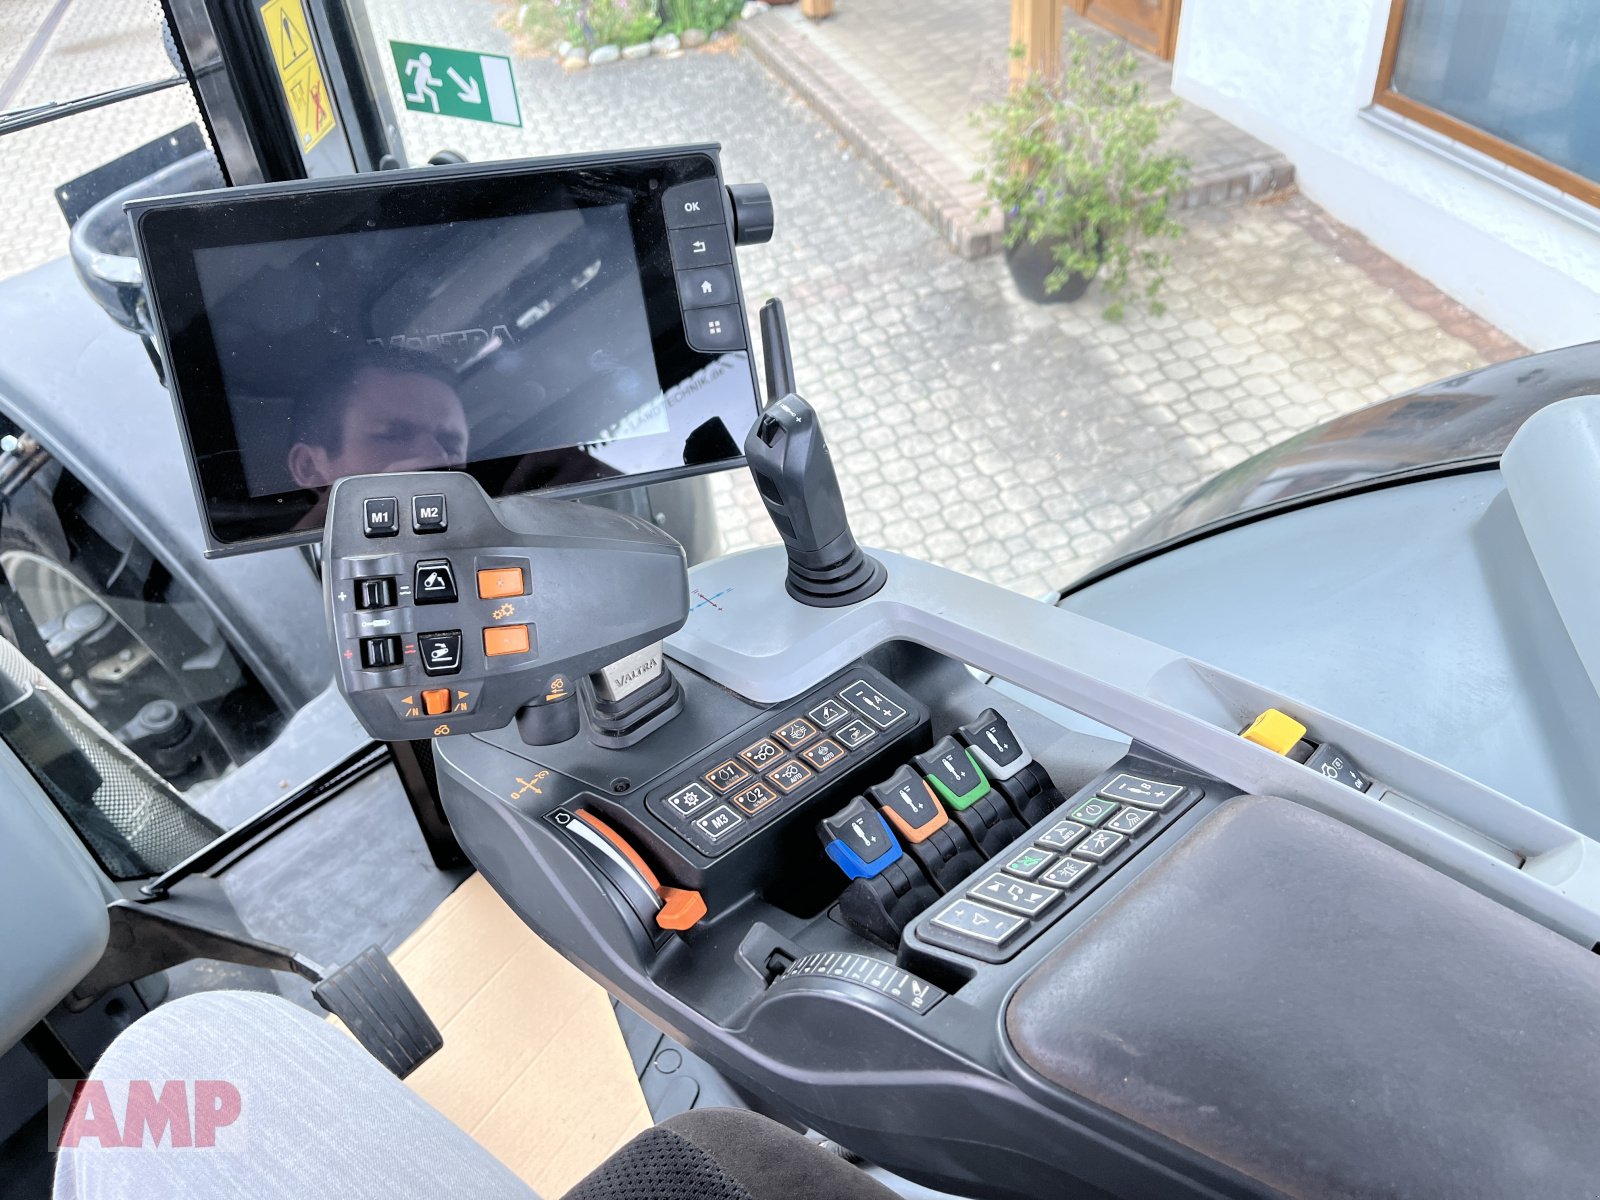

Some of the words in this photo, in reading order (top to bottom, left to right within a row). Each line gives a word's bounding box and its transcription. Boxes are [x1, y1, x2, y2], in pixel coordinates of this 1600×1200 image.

[684, 201, 700, 212] OK
[371, 511, 389, 523] M1
[420, 507, 439, 518] M2
[615, 658, 657, 688] VALTRA
[874, 695, 882, 704] A
[822, 751, 835, 762] AUTO
[726, 766, 735, 775] 1
[790, 772, 803, 783] AUTO
[755, 788, 764, 798] 2
[711, 813, 729, 829] M3
[911, 996, 923, 1008] 10
